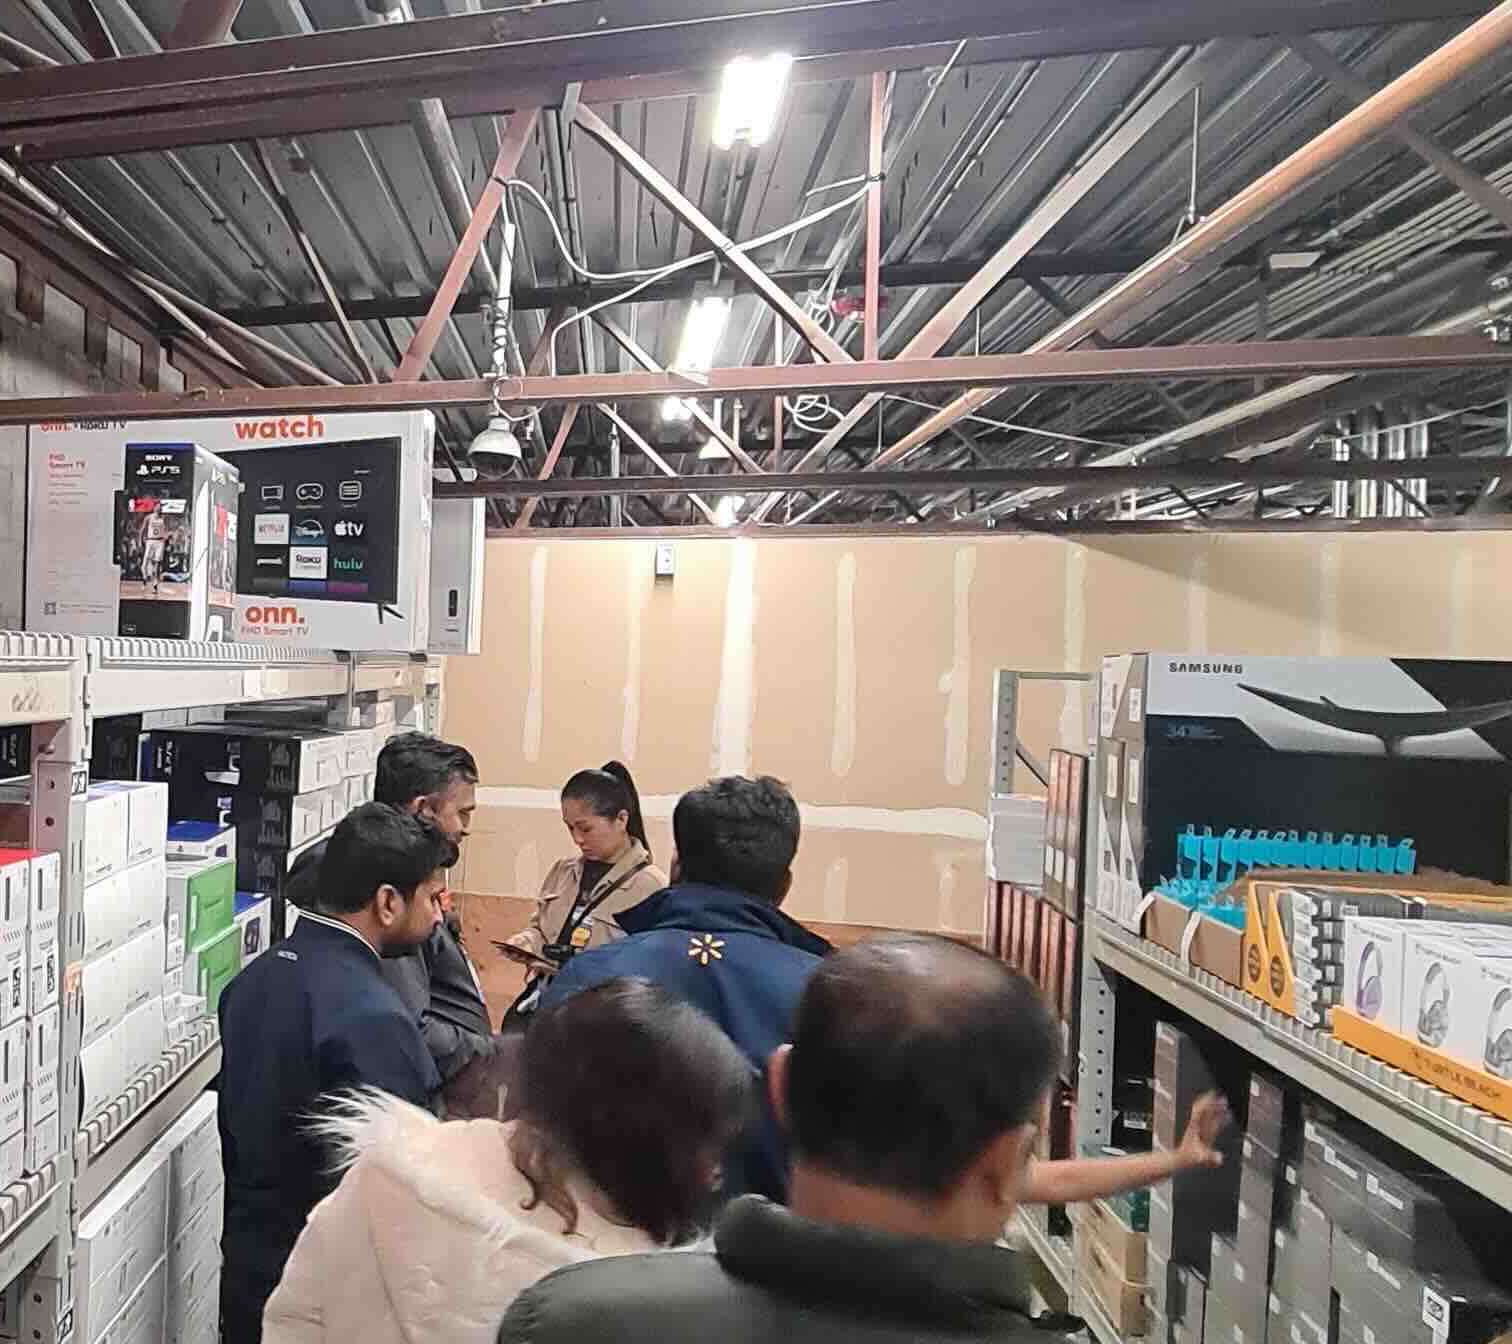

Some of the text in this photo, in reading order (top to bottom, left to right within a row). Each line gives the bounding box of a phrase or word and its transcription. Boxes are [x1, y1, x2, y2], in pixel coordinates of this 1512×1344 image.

[235, 415, 324, 439] watch
[333, 557, 363, 570] hulu
[246, 606, 304, 624] onn.
[1169, 663, 1242, 674] SAMSUNG
